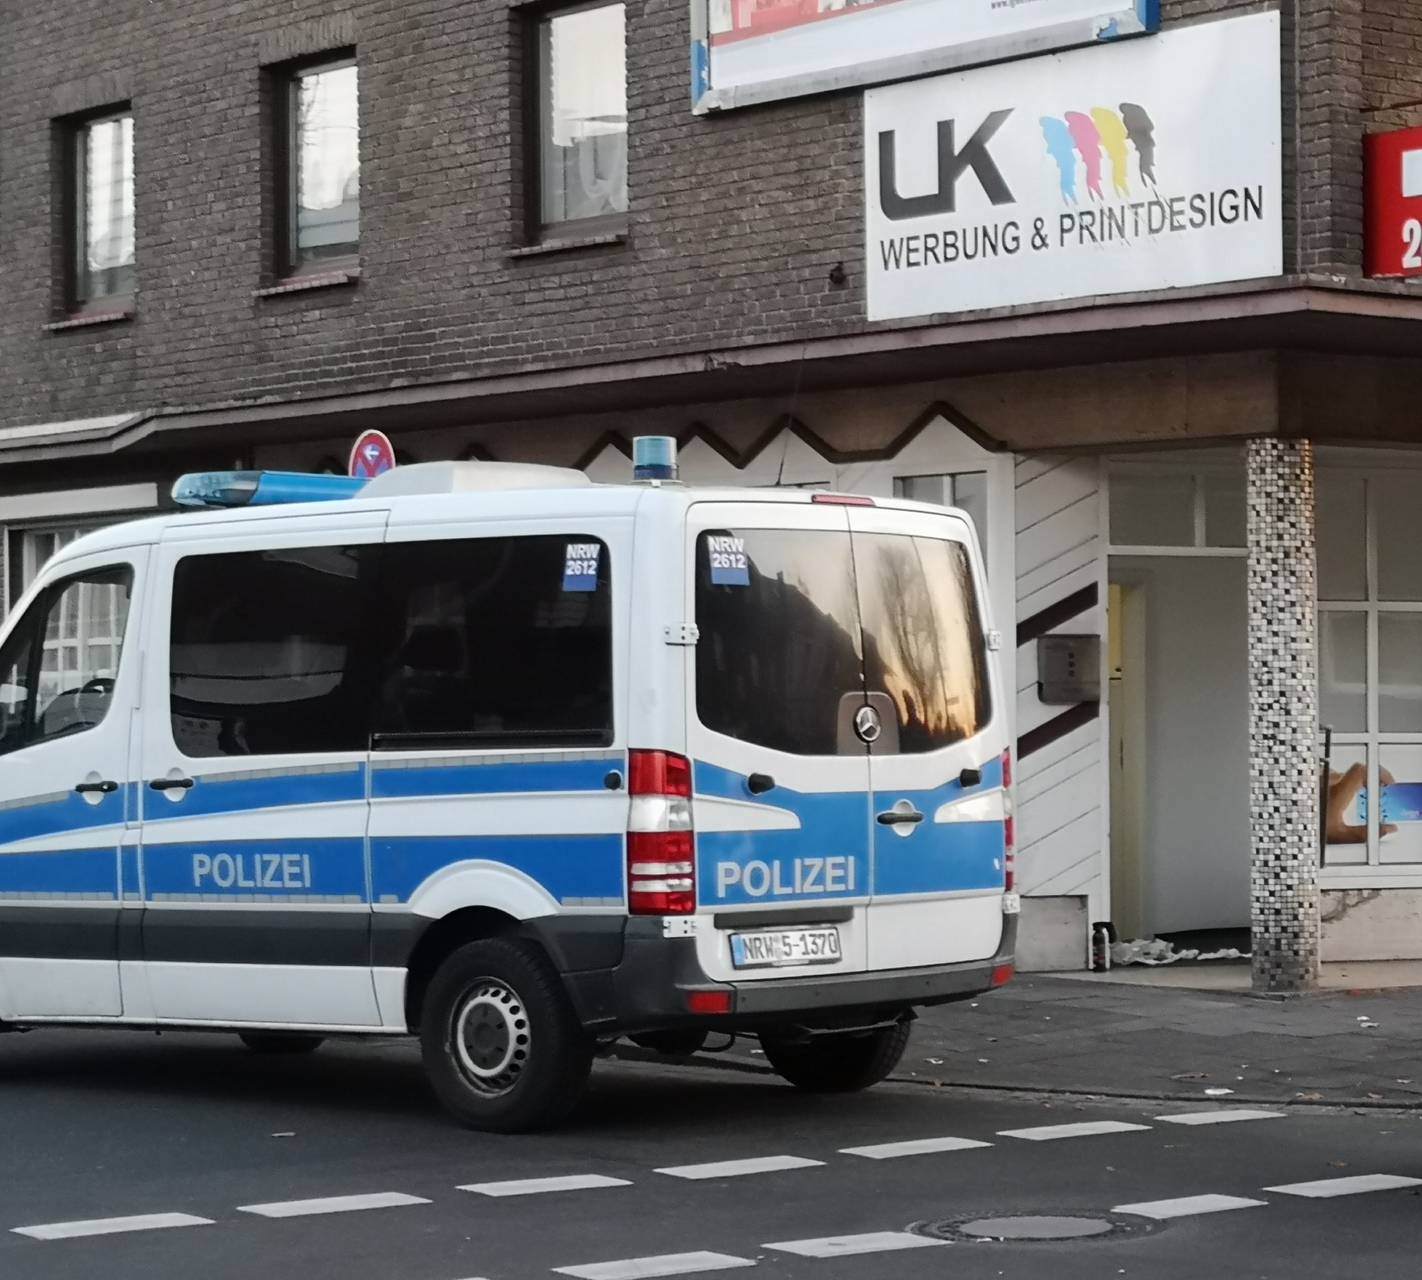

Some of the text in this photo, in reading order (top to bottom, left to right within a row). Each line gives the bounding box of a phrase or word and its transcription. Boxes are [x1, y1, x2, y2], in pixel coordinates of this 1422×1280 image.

[880, 184, 1263, 271] WERBUNG & PRINTDESIGN
[566, 543, 600, 559] NRW
[707, 535, 745, 552] NRW
[566, 560, 597, 575] 2612
[712, 552, 746, 568] 2612
[192, 853, 312, 888] POLIZEI
[717, 855, 855, 898] POLIZEI
[742, 932, 838, 960] NRW 5-1370
